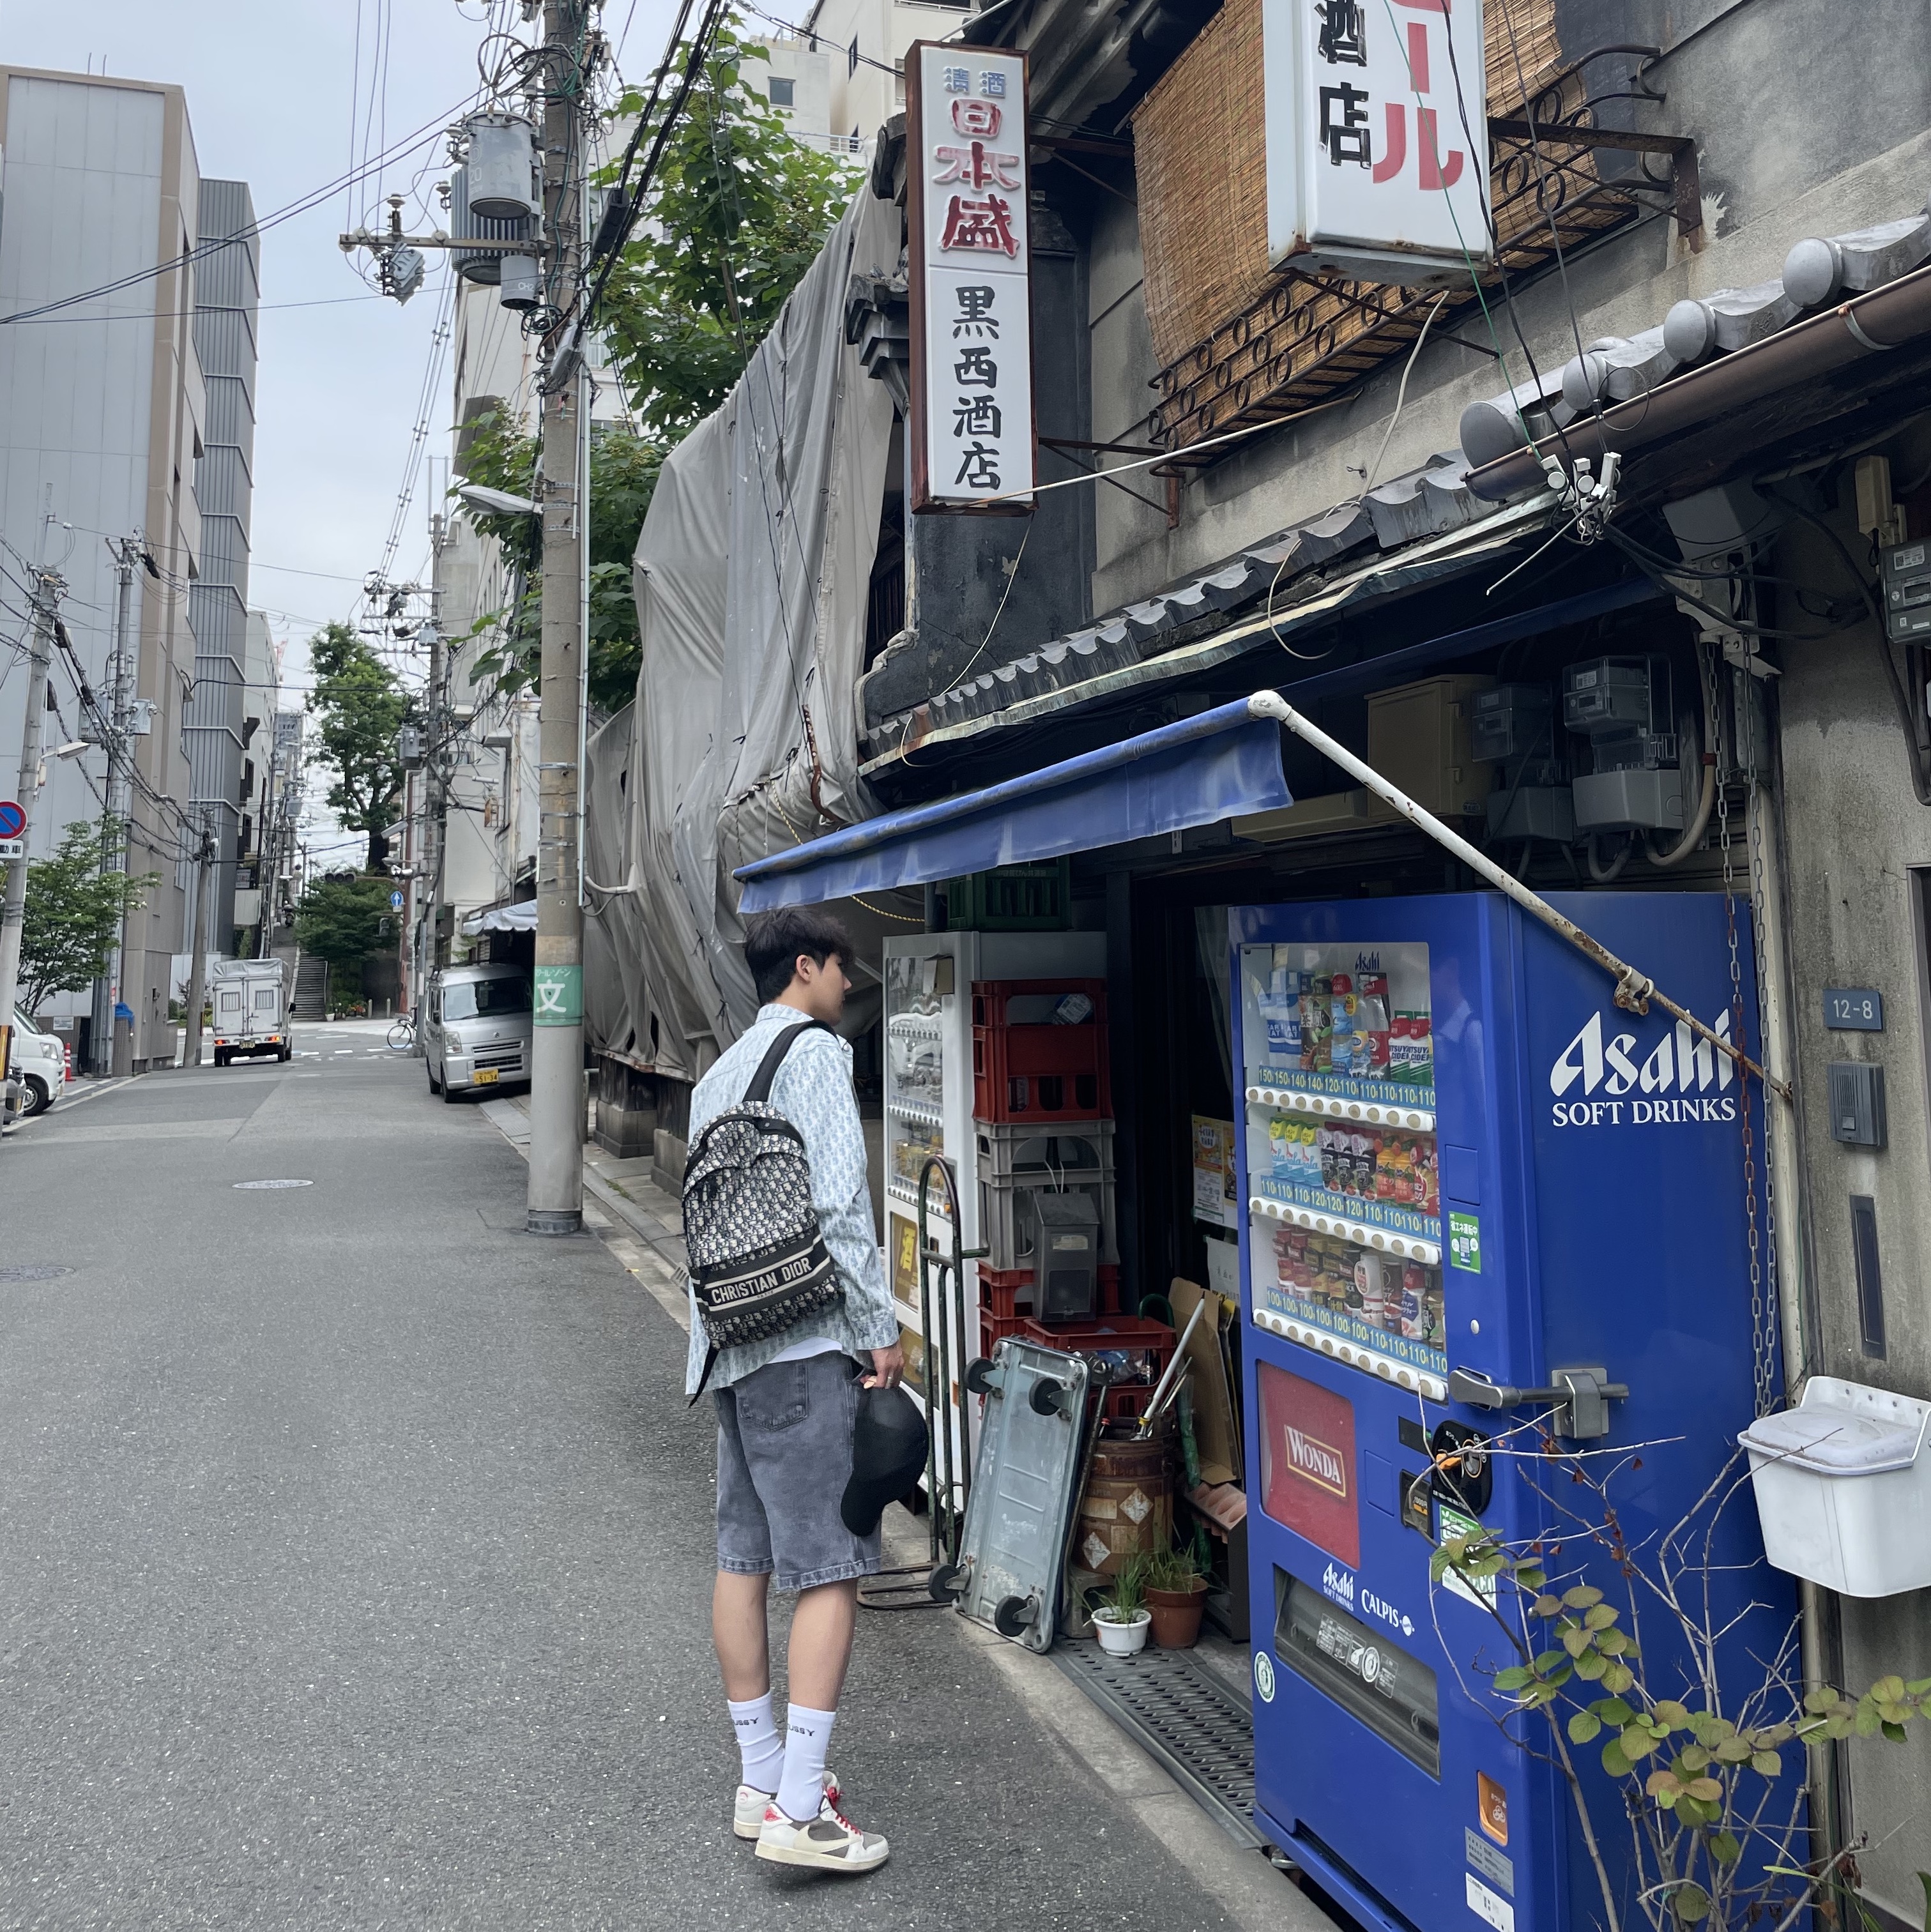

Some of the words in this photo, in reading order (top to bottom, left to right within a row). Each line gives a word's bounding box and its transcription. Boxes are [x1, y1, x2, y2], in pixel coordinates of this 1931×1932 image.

[943, 66, 1005, 98] 清酒
[933, 98, 1022, 259] 日本盛
[952, 285, 1002, 491] 黒西酒店
[1355, 950, 1380, 971] Asahi
[537, 978, 567, 1013] 文
[1833, 998, 1873, 1020] 12-8
[1550, 1007, 1734, 1097] Asahi
[1552, 1100, 1624, 1127] SOFT
[1631, 1097, 1736, 1124] DRINKS
[711, 1272, 779, 1304] CHRISTIAN
[781, 1257, 813, 1282] DIOR
[1286, 1426, 1341, 1485] WONDA
[1323, 1562, 1354, 1601] Asahi
[1361, 1588, 1400, 1628] CALPIS
[735, 1717, 759, 1726] SSY
